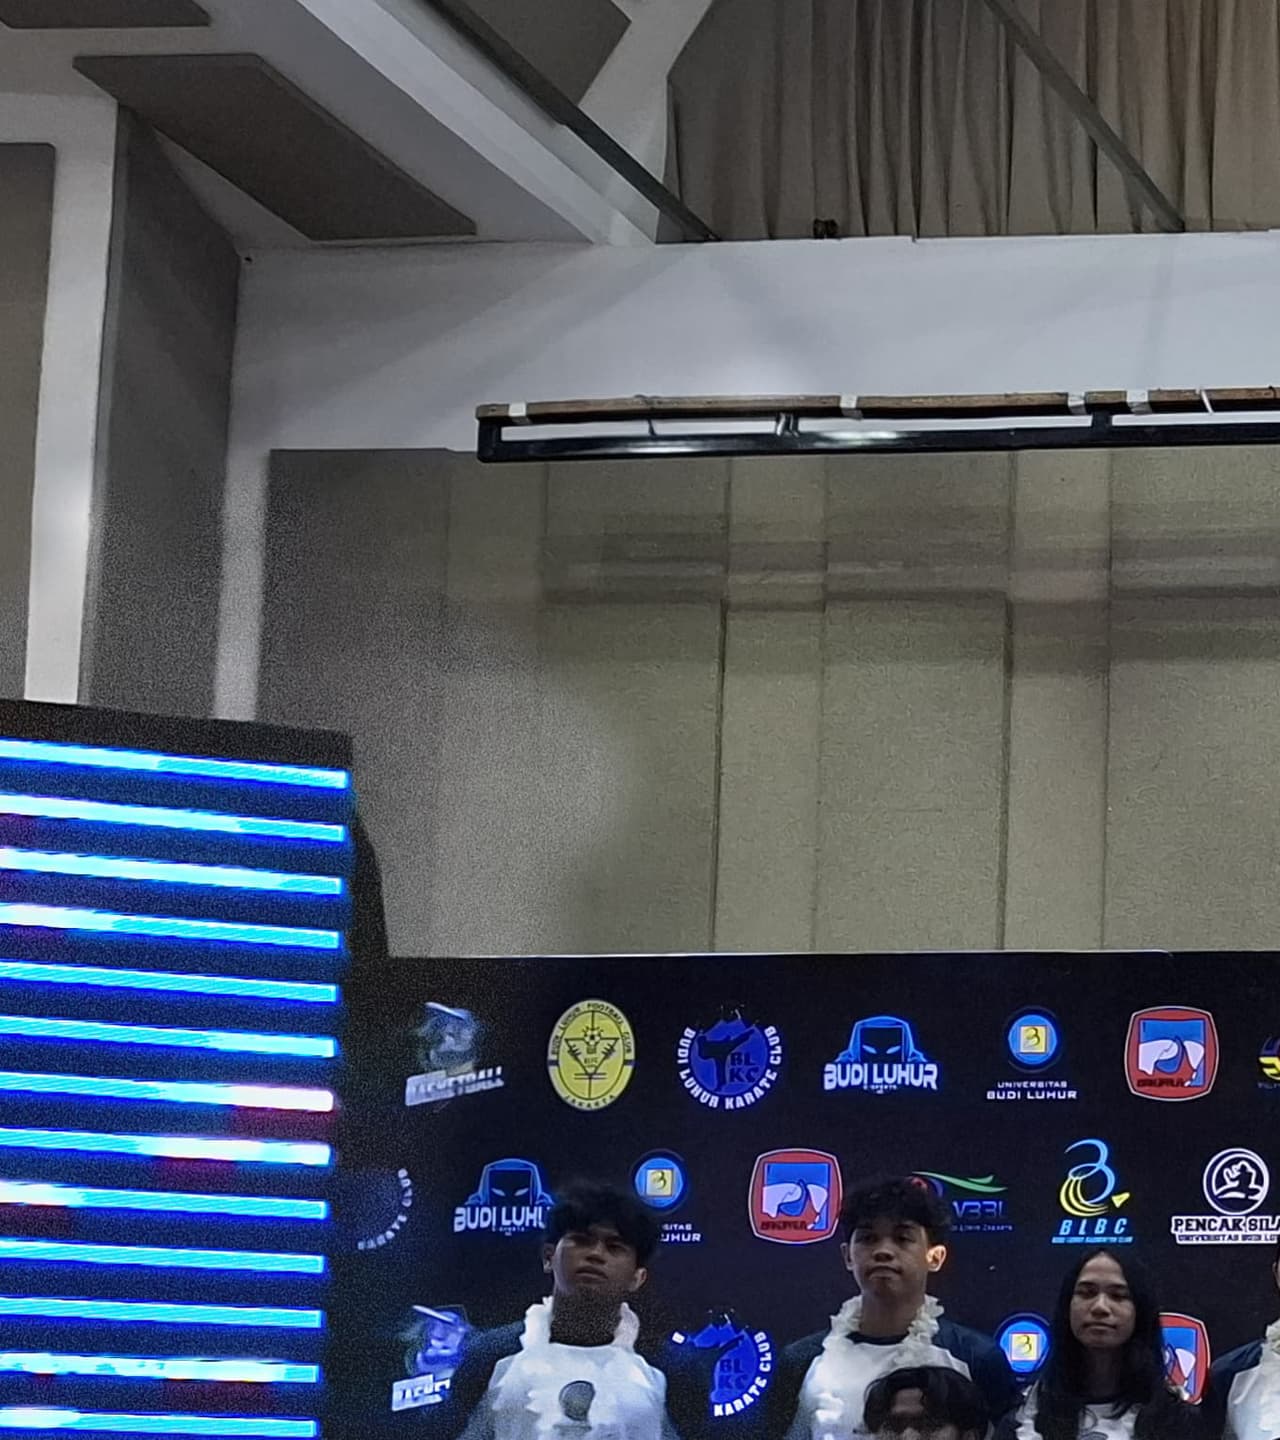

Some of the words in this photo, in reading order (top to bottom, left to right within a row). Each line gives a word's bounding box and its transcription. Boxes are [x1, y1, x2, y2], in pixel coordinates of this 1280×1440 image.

[677, 1027, 696, 1064] BUDI
[764, 1026, 782, 1065] CLUB
[679, 1069, 719, 1108] LUHUR
[725, 1069, 777, 1109] KARATE
[824, 1063, 868, 1090] BUDI
[872, 1064, 938, 1090] LUHUR
[987, 1091, 1021, 1099] BUDI
[1027, 1091, 1077, 1099] LUHUR
[454, 1206, 496, 1233] BUDI
[1173, 1218, 1246, 1232] PENCAK
[714, 1376, 767, 1416] KARATE
[754, 1332, 772, 1372] CLUB
